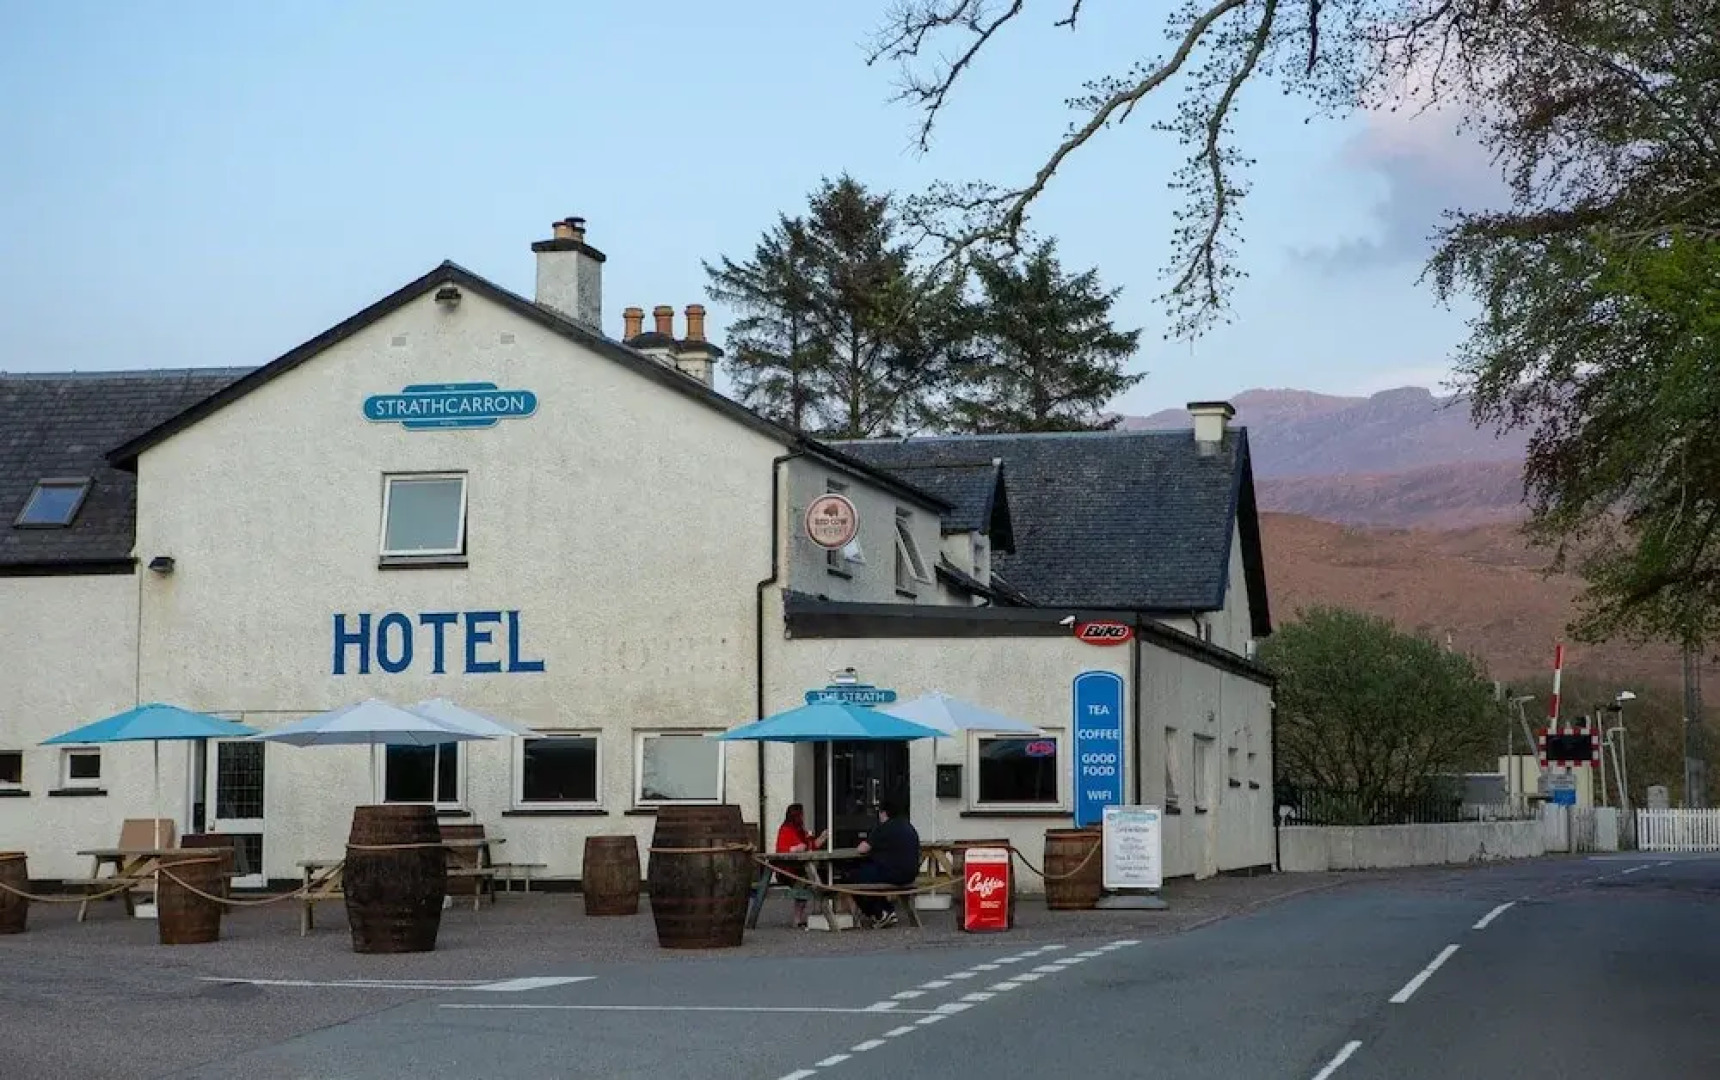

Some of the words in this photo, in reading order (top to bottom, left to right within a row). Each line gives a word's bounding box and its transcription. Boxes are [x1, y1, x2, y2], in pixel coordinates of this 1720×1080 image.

[376, 396, 525, 416] STRATHCARRON
[332, 611, 545, 675] HOTEL
[842, 692, 885, 703] STRATH
[1087, 704, 1110, 716] TEA
[1078, 728, 1120, 740] COFFEE
[1081, 753, 1117, 764] GOOD
[1083, 765, 1116, 776] FOOD
[1086, 790, 1112, 801] WIFI
